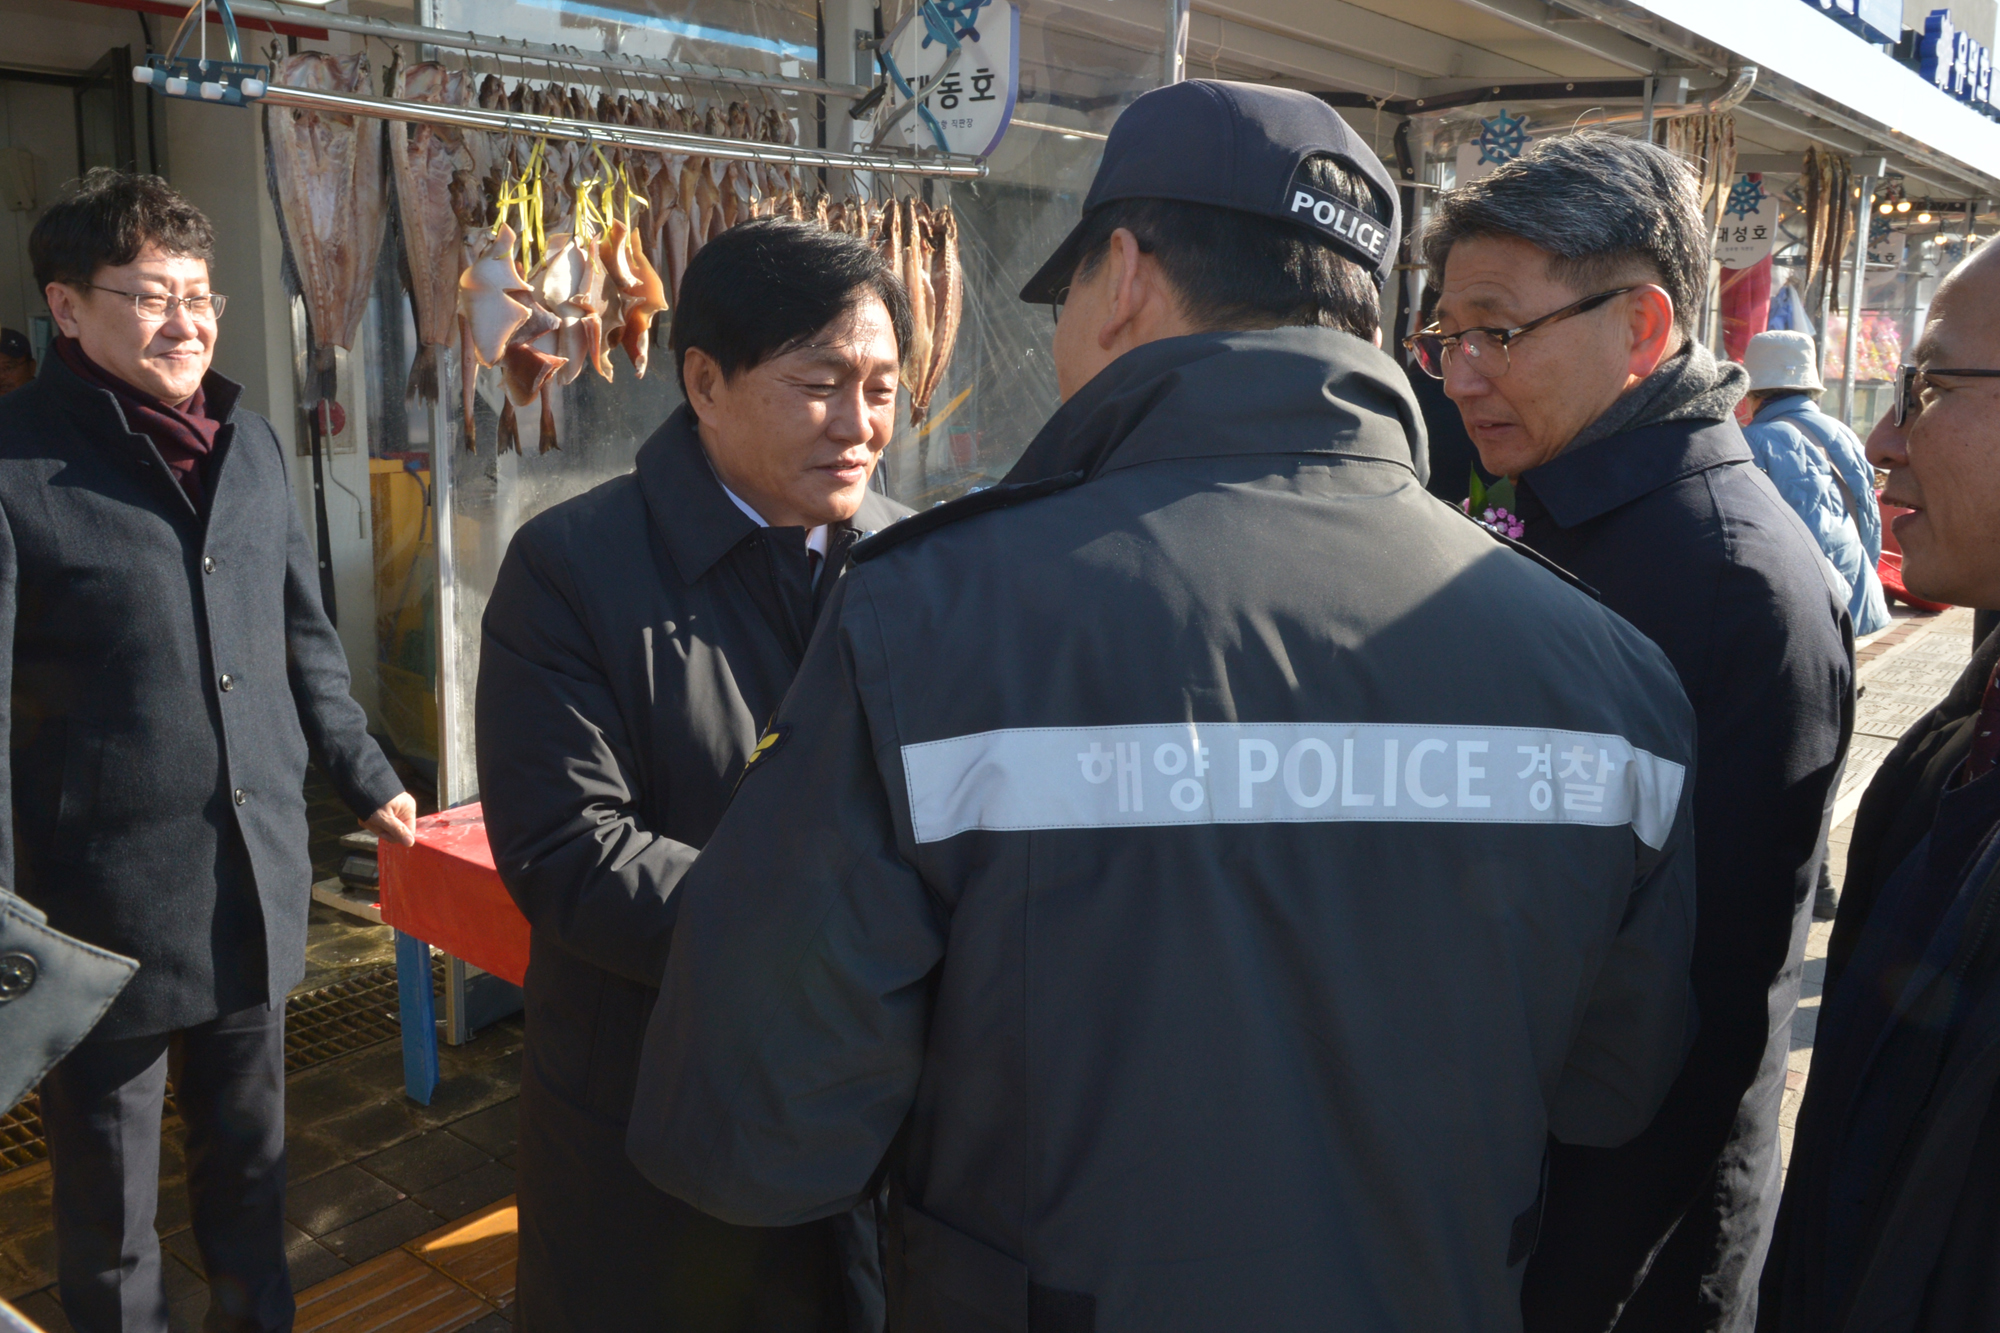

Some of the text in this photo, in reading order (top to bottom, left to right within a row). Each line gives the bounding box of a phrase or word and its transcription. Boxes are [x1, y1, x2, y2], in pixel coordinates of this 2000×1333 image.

[951, 118, 973, 129] 직판장
[1291, 190, 1385, 255] POLICE
[1717, 225, 1767, 243] 대성호
[1077, 738, 1615, 813] 해양 POLICE 경찰
